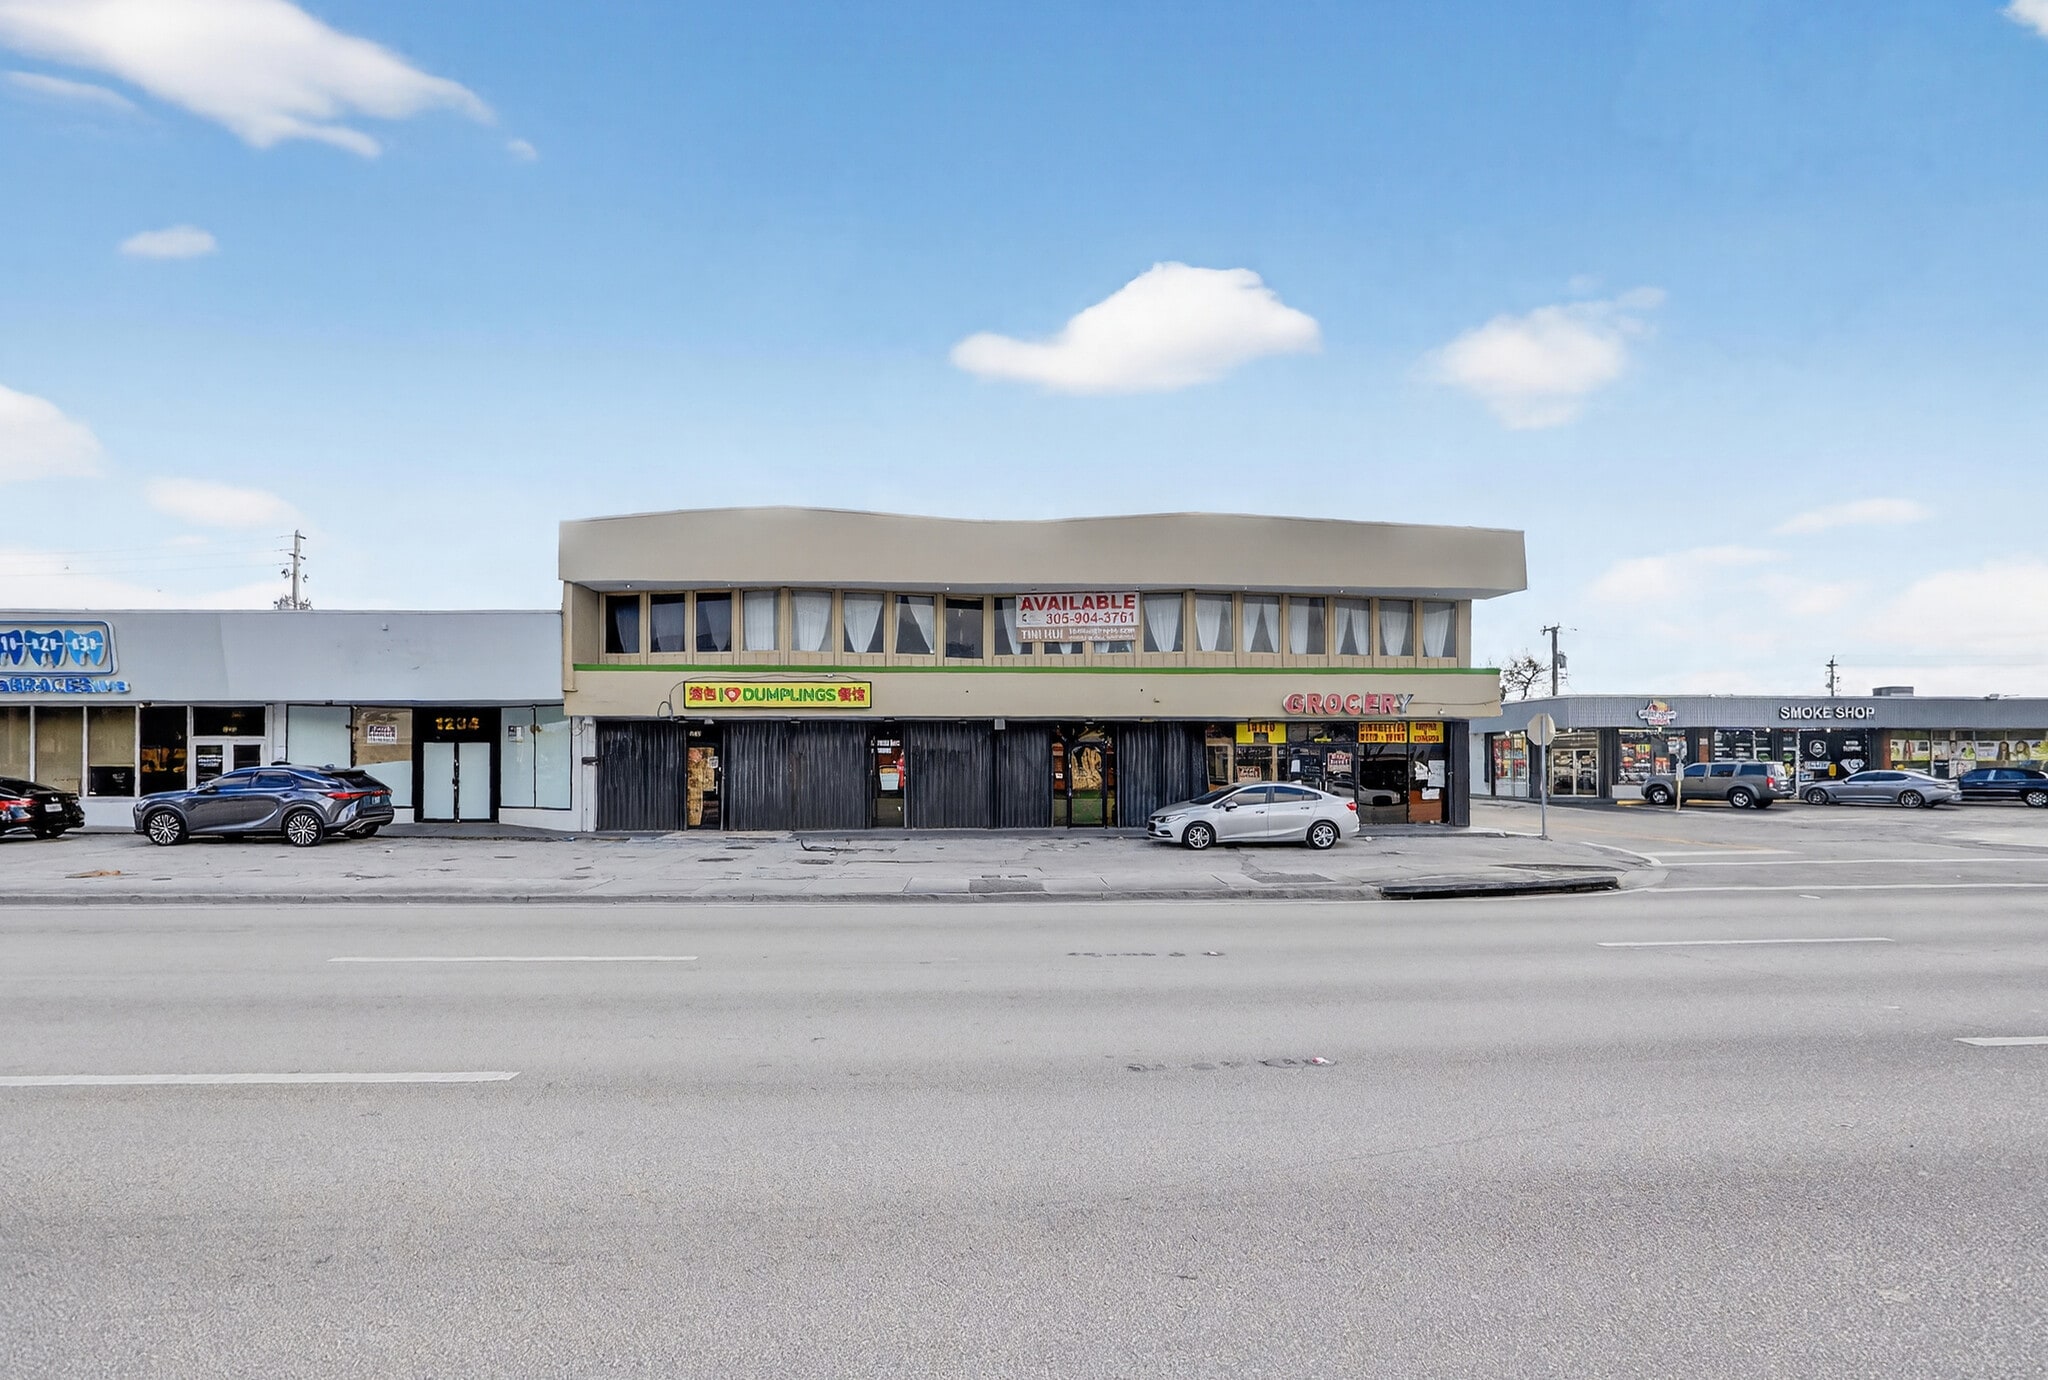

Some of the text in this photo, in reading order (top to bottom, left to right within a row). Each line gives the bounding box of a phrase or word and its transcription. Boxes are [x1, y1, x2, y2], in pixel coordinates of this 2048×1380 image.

[1020, 594, 1136, 611] AVAILABLE
[743, 687, 837, 702] DUMPLINGS
[1283, 692, 1414, 716] GROCERY
[1780, 706, 1875, 719] SMOKE SHOP
